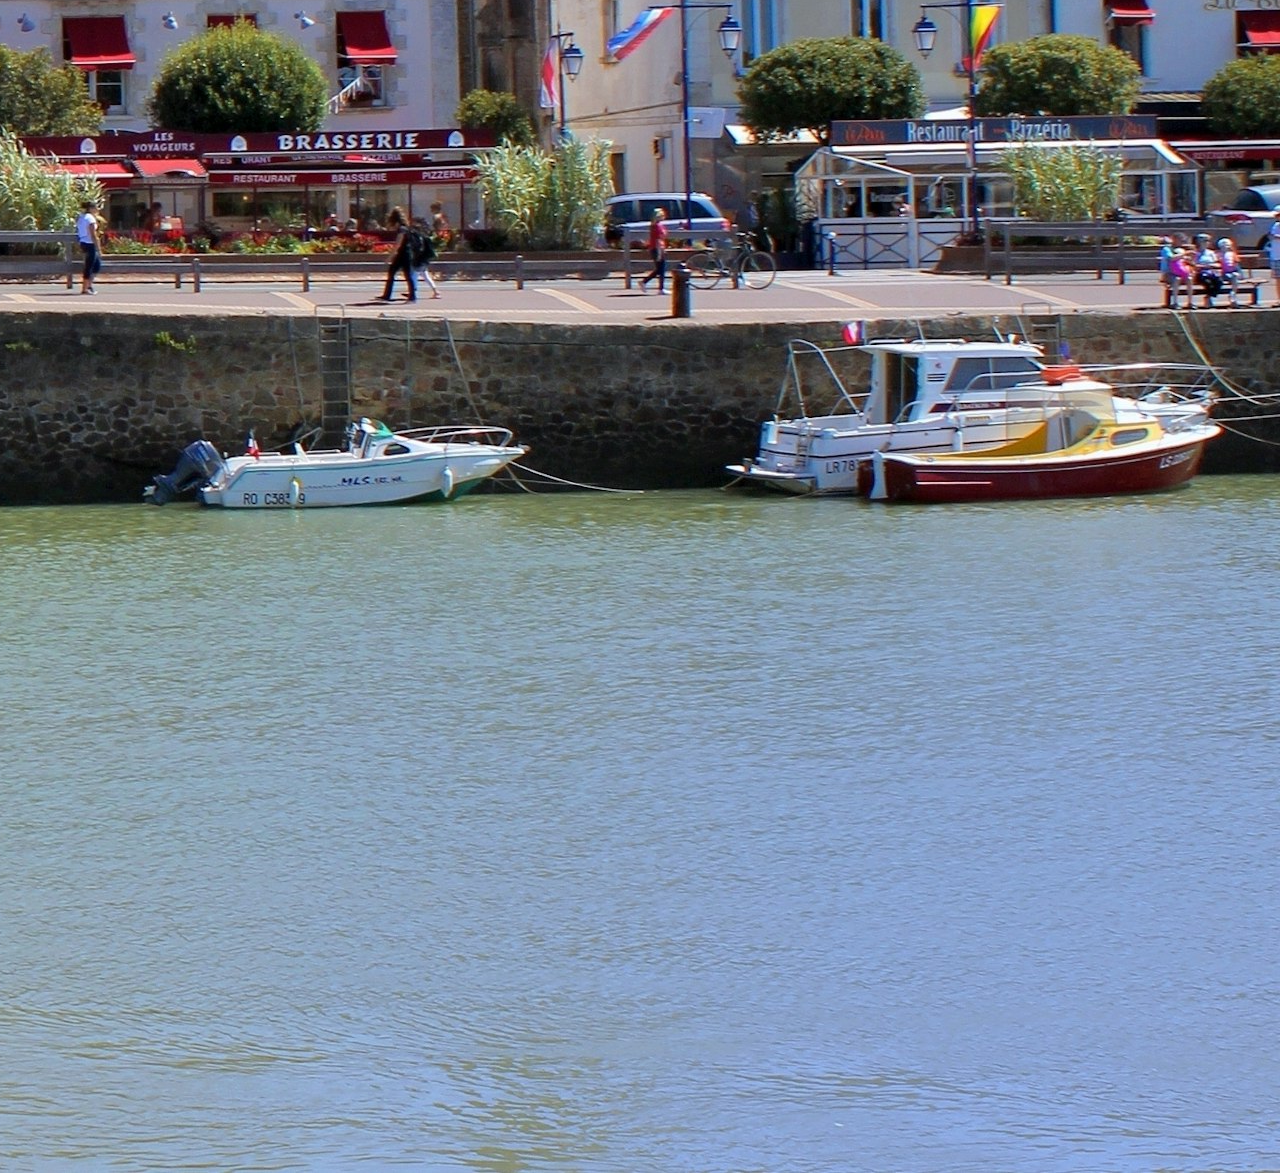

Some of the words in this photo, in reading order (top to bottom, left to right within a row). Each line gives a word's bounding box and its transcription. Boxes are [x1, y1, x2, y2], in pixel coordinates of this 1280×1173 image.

[154, 133, 174, 141] LES
[278, 133, 420, 150] BRASSERIE
[133, 143, 195, 152] VOYAGEURS
[233, 175, 297, 183] RESTAURANT
[331, 173, 387, 183] BRASSERIE
[422, 170, 466, 180] PIZZERIA
[264, 493, 306, 505] C3839
